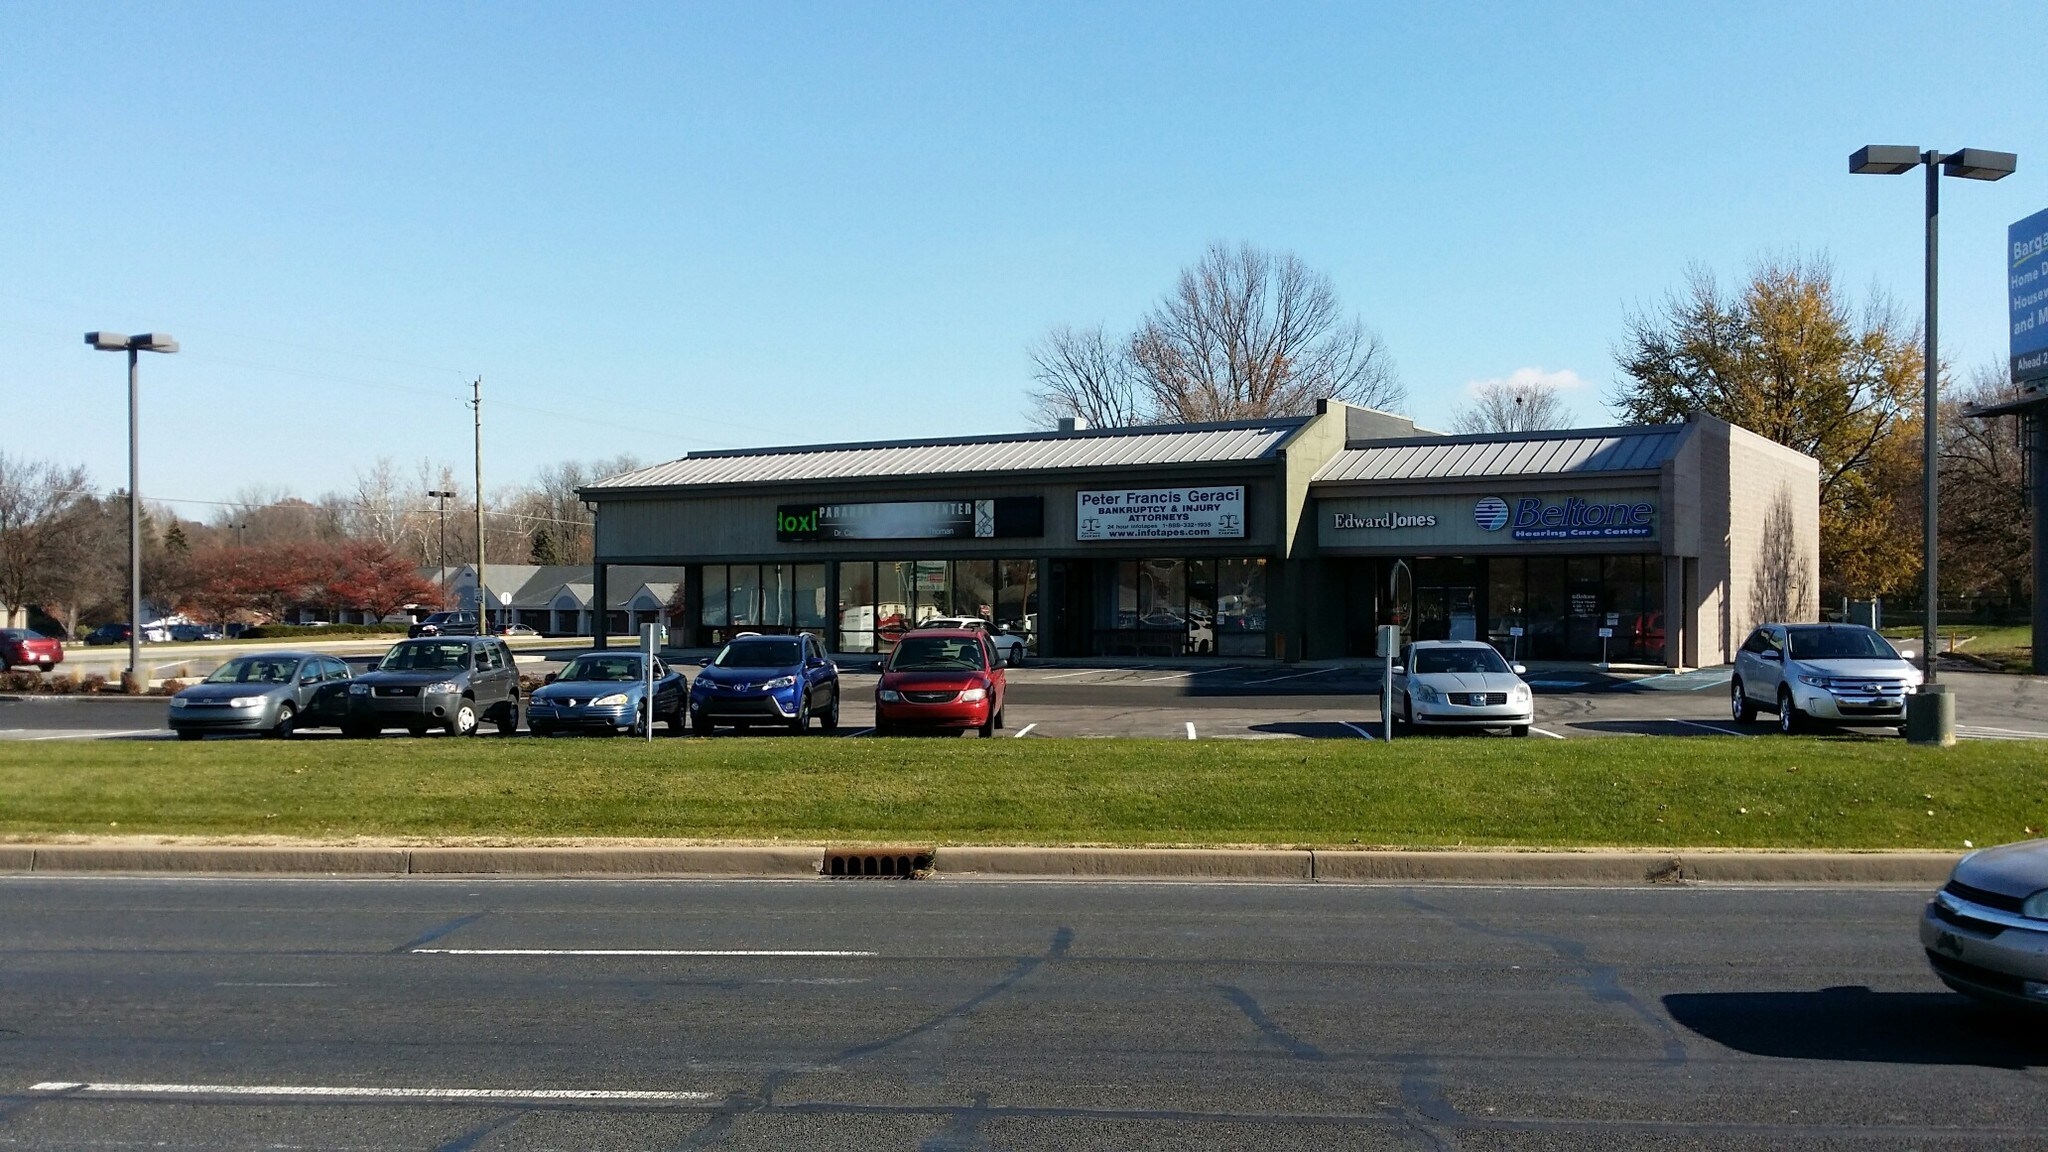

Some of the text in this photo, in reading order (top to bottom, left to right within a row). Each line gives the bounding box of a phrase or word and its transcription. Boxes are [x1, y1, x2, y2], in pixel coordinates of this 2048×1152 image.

[2011, 270, 2038, 289] Home
[2014, 312, 2034, 335] and
[2017, 353, 2041, 371] Ahead
[1082, 489, 1239, 505] Peter Francis Geraci
[1098, 504, 1221, 515] BANKRUPTCY & INJURY
[1128, 513, 1190, 522] ATTORNEYS
[1511, 497, 1653, 529] Beltone
[1334, 512, 1436, 529] Edward Jones
[1108, 529, 1211, 537] www.infotapes.com
[1515, 530, 1567, 538] Hearing
